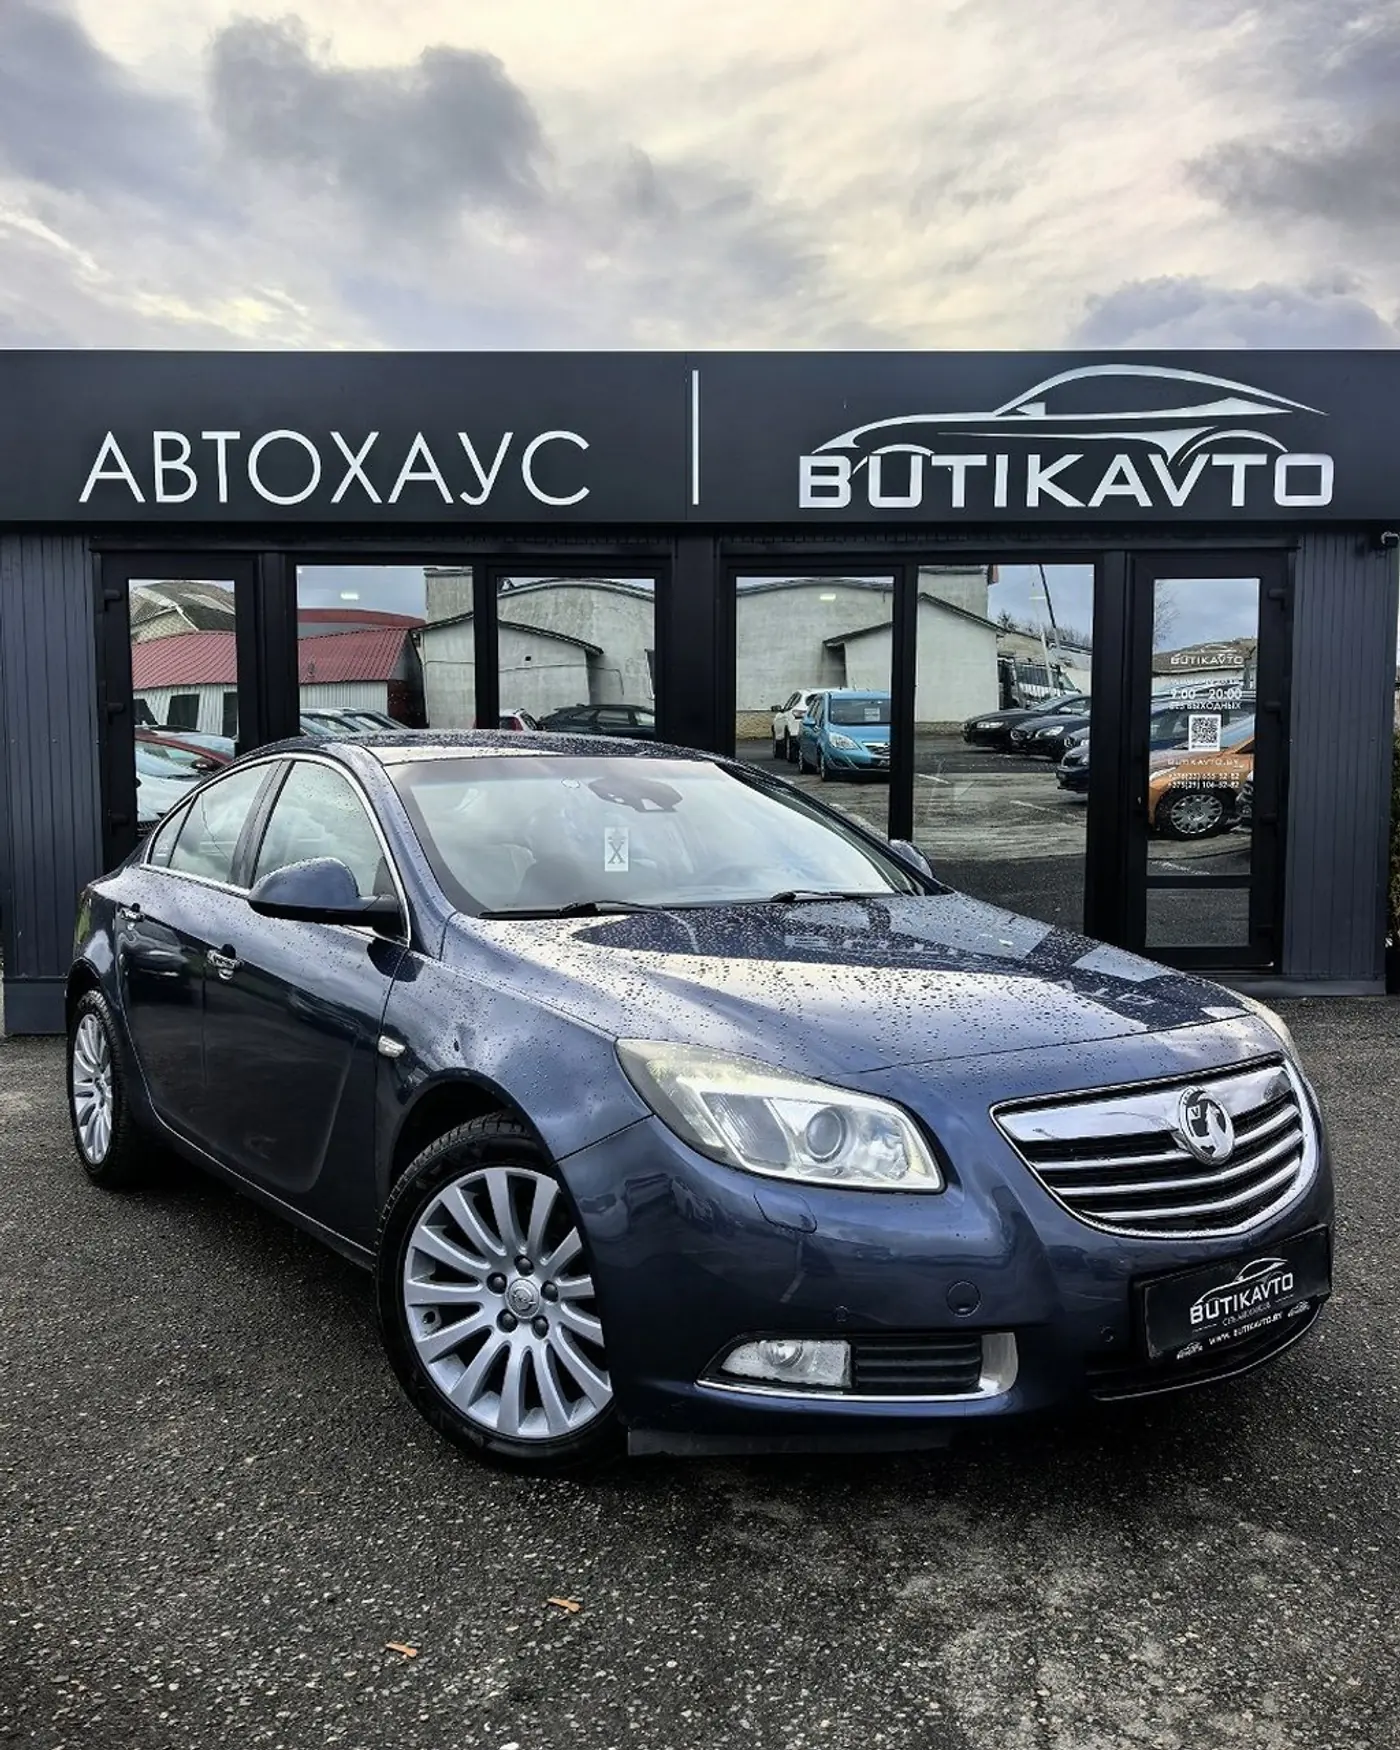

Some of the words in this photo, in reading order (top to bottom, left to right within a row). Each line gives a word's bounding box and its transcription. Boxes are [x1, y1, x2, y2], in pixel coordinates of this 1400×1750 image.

[79, 429, 590, 506] АВТОХАУС
[799, 453, 1334, 508] BUTIKAVTO
[1171, 655, 1244, 665] BUTIKAVTO
[1190, 1272, 1294, 1325] BUTIKAVTO
